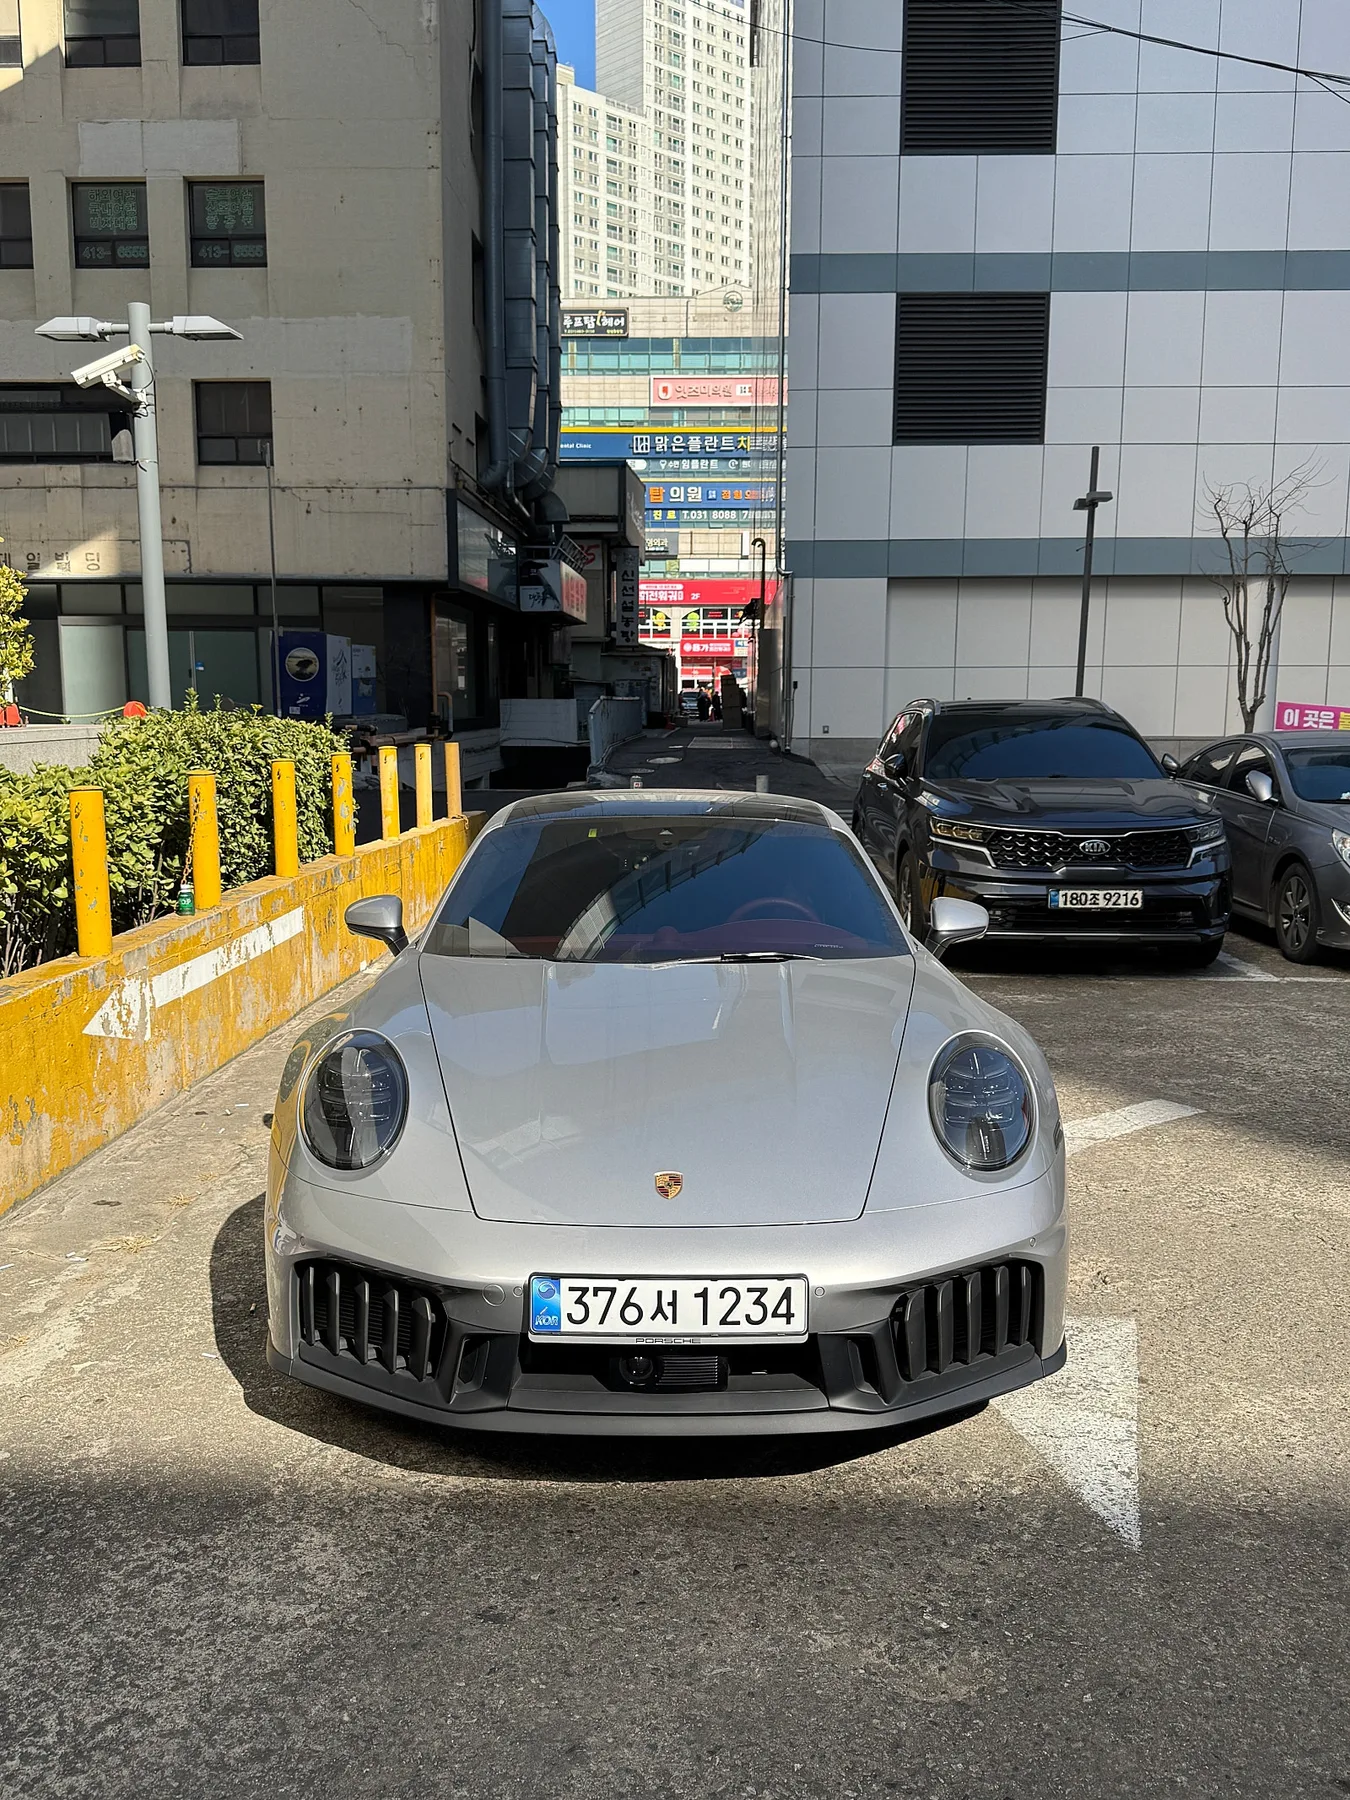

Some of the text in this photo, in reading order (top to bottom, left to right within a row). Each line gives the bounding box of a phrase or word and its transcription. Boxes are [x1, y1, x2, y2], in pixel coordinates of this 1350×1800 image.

[88, 188, 137, 201] 해외여행
[88, 203, 138, 216] 국내여행
[563, 314, 625, 329] 루프탑 헤어
[682, 459, 719, 469] 임플란트
[682, 510, 708, 520] T.031
[711, 510, 737, 520] 8088
[691, 592, 701, 600] 2F
[620, 569, 635, 643] 신선설농탕
[1283, 708, 1300, 727] 이
[1303, 709, 1335, 730] 곳은
[1084, 842, 1106, 852] KIA
[1061, 892, 1139, 907] 180조 9216
[566, 1286, 795, 1326] 376서 1234
[534, 1315, 558, 1327] KOR
